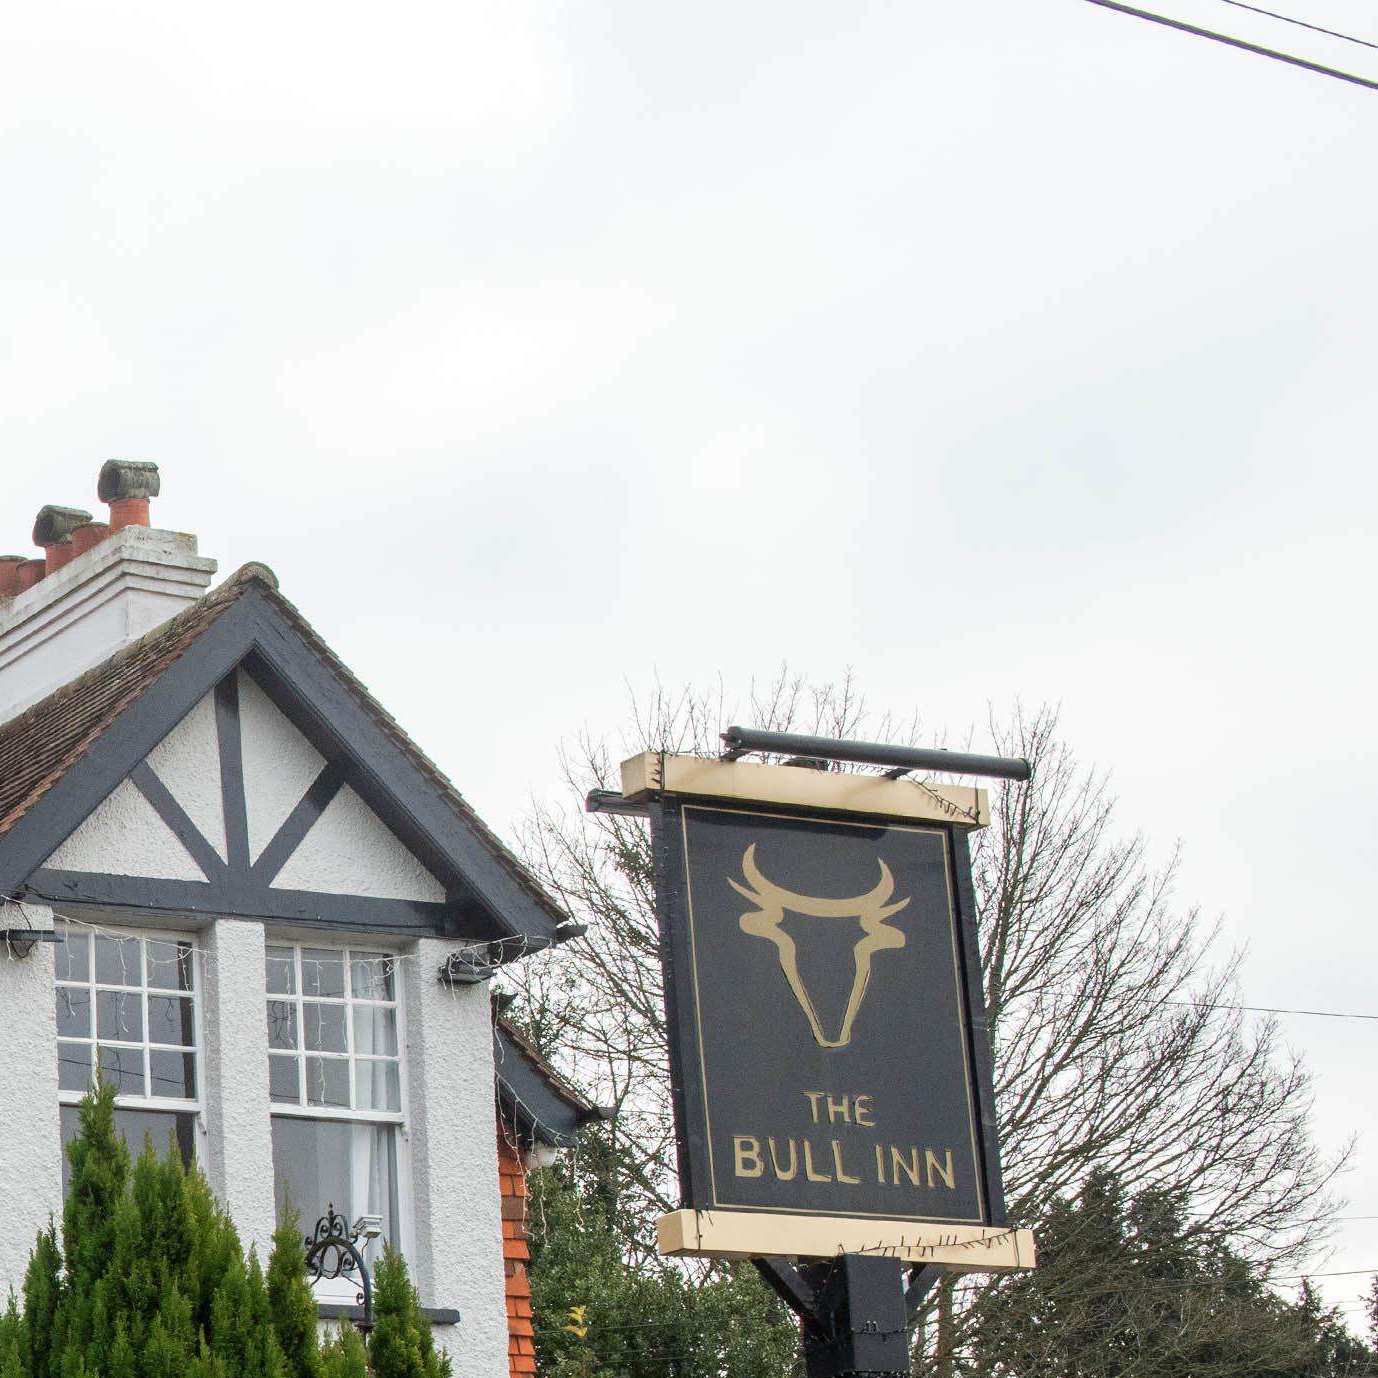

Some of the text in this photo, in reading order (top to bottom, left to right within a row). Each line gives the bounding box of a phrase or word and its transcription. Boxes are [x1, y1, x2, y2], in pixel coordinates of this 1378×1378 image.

[803, 1091, 877, 1127] THE
[733, 1135, 956, 1190] BULL INN
